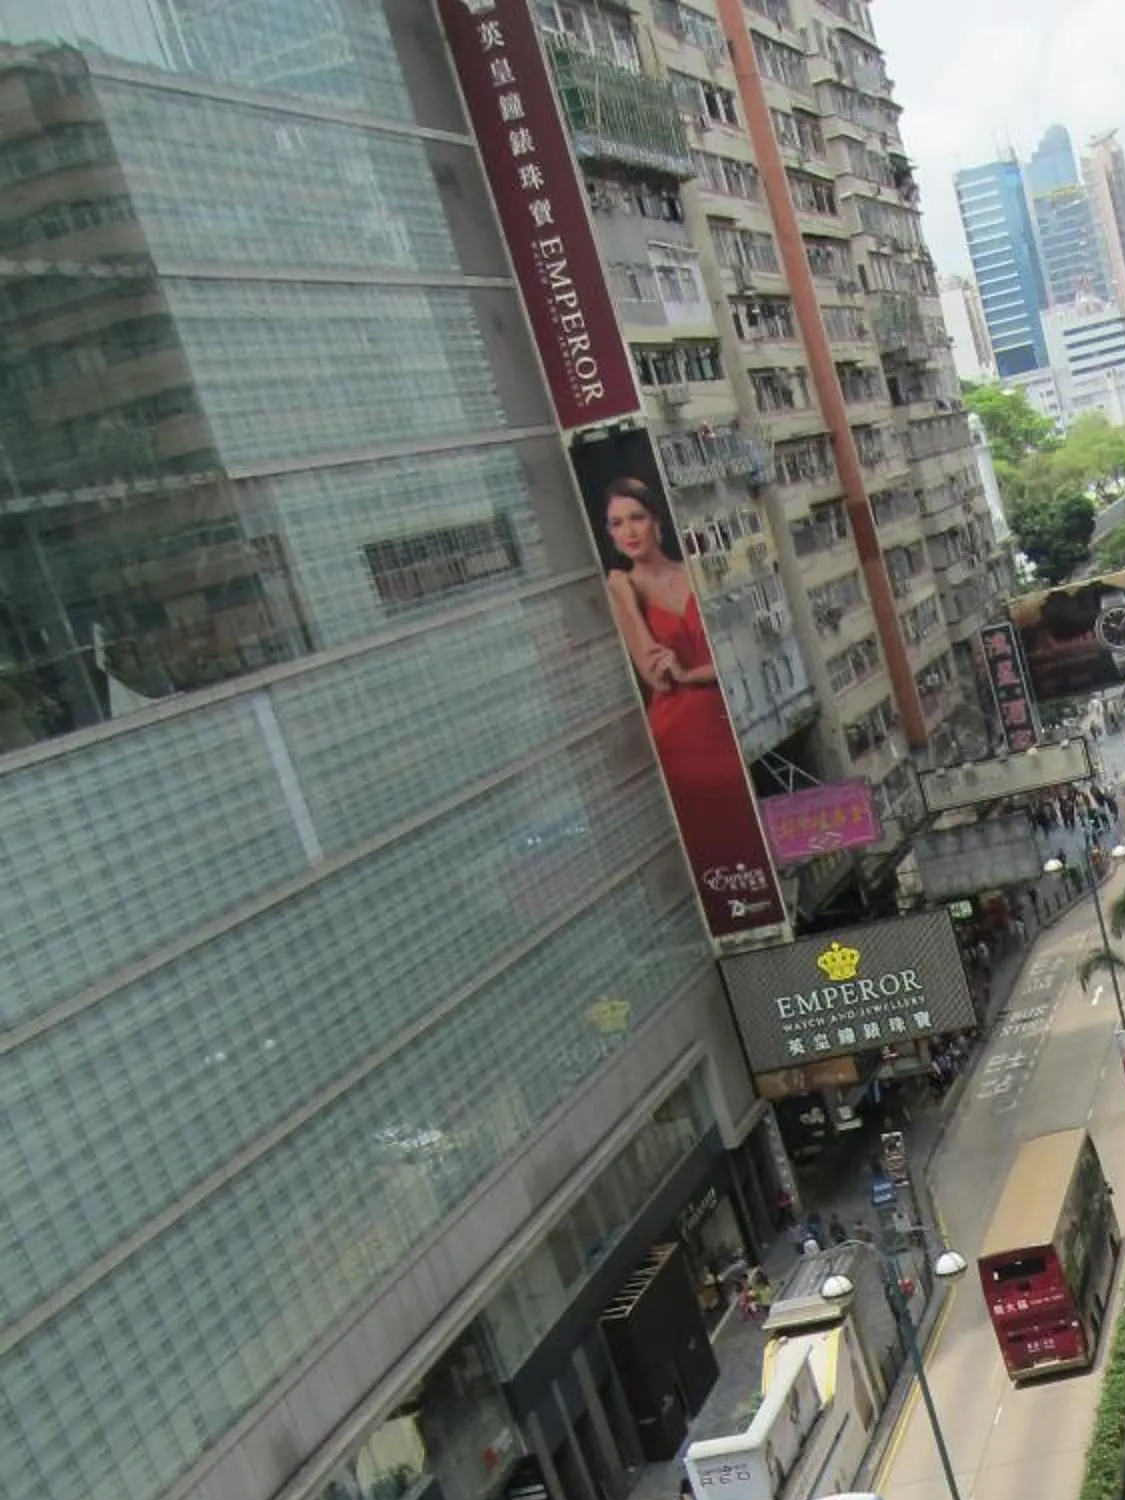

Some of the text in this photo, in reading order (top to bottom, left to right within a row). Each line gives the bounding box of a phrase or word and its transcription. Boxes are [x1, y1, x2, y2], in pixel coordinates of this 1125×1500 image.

[539, 235, 605, 407] EMPEROR
[775, 969, 923, 1020] EMPEROR
[783, 995, 926, 1033] WATCH AND JEWELLERY
